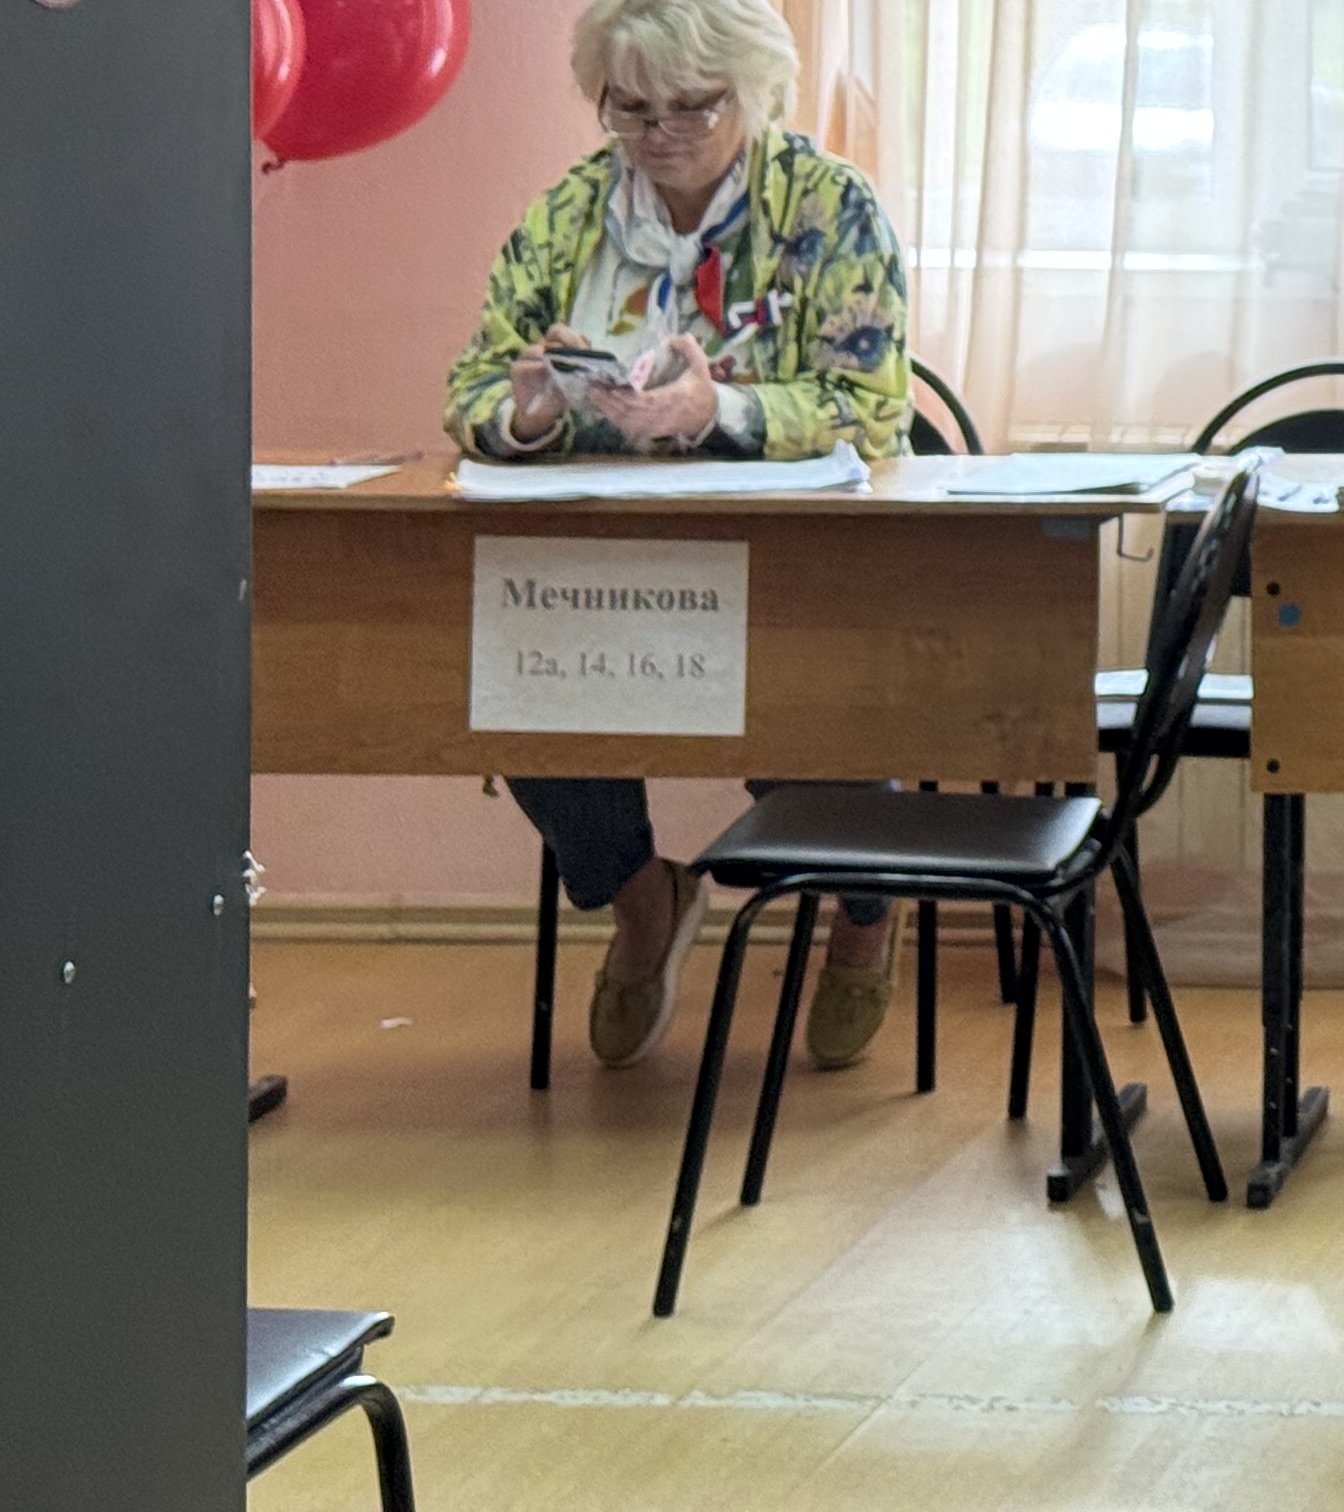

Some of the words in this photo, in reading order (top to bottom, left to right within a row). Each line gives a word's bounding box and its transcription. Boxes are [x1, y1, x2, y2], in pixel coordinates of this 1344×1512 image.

[502, 577, 720, 612] Мечникова
[580, 652, 616, 679] 14,
[628, 653, 664, 680] 16,
[676, 654, 706, 679] 18
